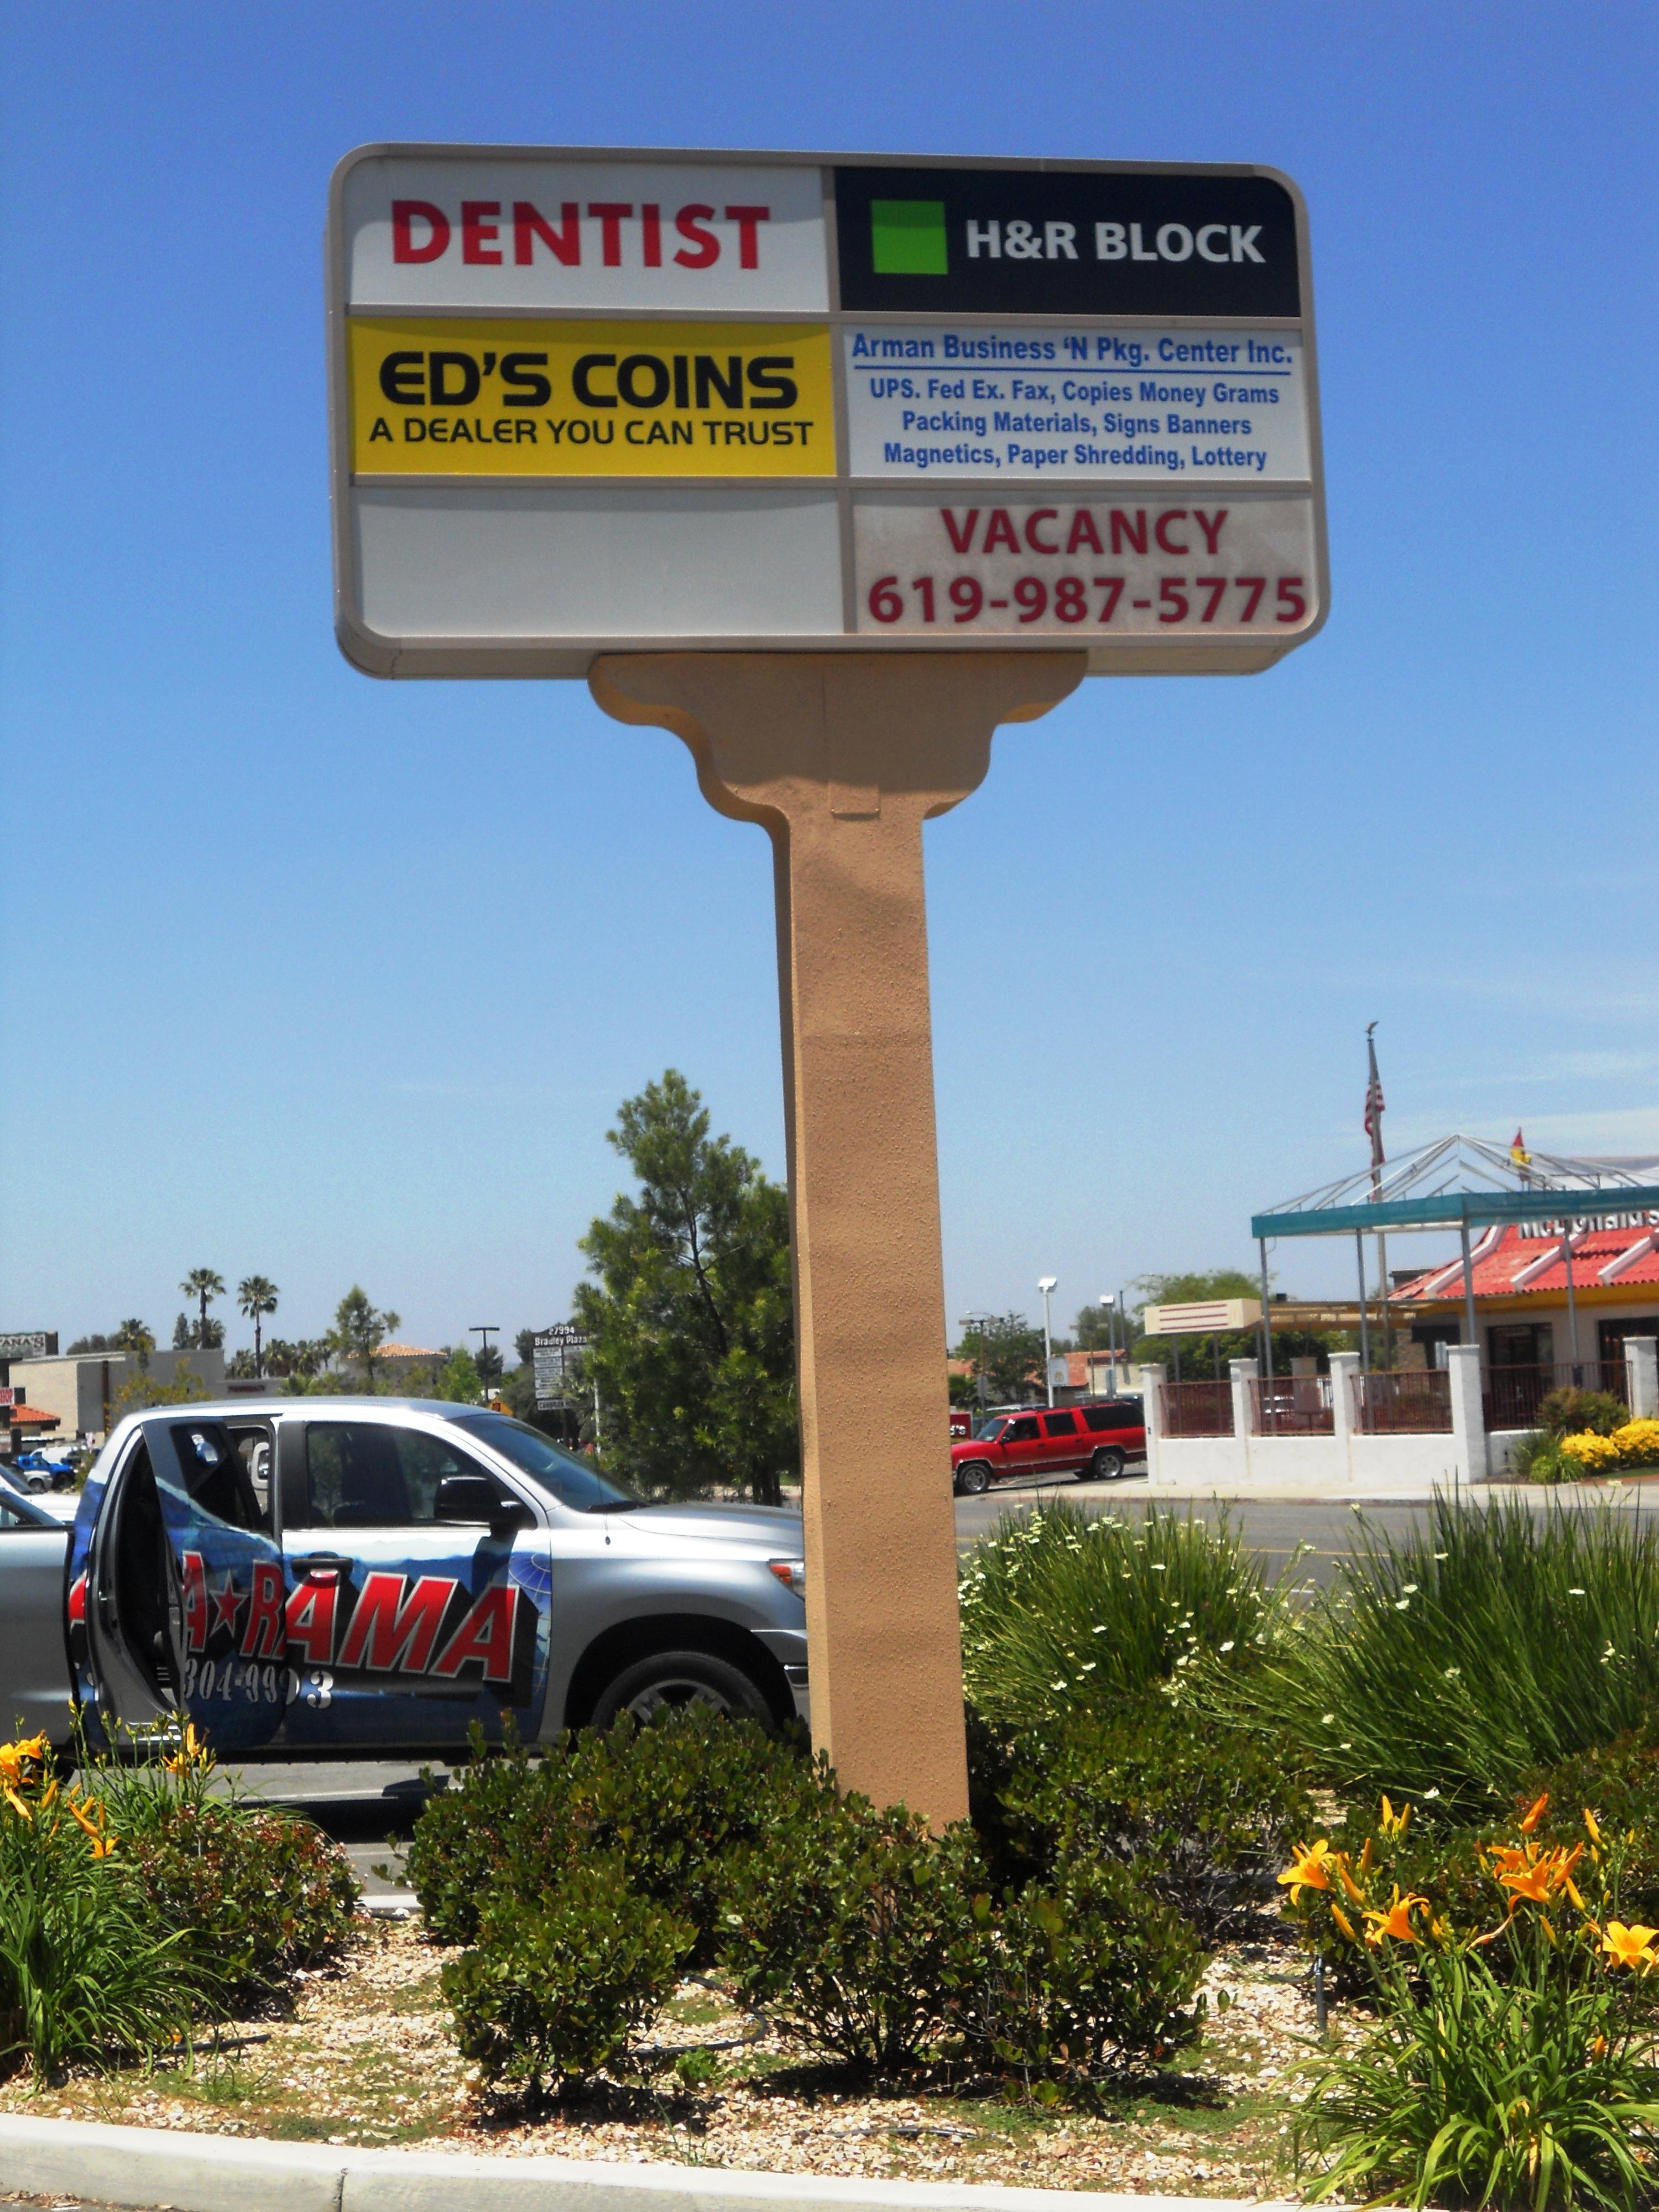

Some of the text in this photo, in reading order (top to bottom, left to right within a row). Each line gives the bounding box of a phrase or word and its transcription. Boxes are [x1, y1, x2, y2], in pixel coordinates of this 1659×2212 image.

[392, 200, 770, 269] DENTIST
[967, 220, 1266, 263] H&R BLOCK
[852, 333, 935, 357] Arman
[943, 334, 1056, 360] Business
[1097, 337, 1150, 367] Pkg.
[1158, 338, 1240, 363] Center
[1248, 339, 1293, 364] Inc.
[571, 353, 798, 409] COINS
[870, 377, 1280, 408] UPS. Fed Ex. Fax, Copies Money Grams
[369, 416, 814, 446] A DEALER YOU CAN TRUST
[902, 409, 1253, 438] Packing Materials, Signs Banners
[885, 442, 1267, 471] Magnetics, Paper Shredding, Lottery
[942, 509, 1229, 555] VACANCY
[869, 576, 1307, 623] 619-987-5775
